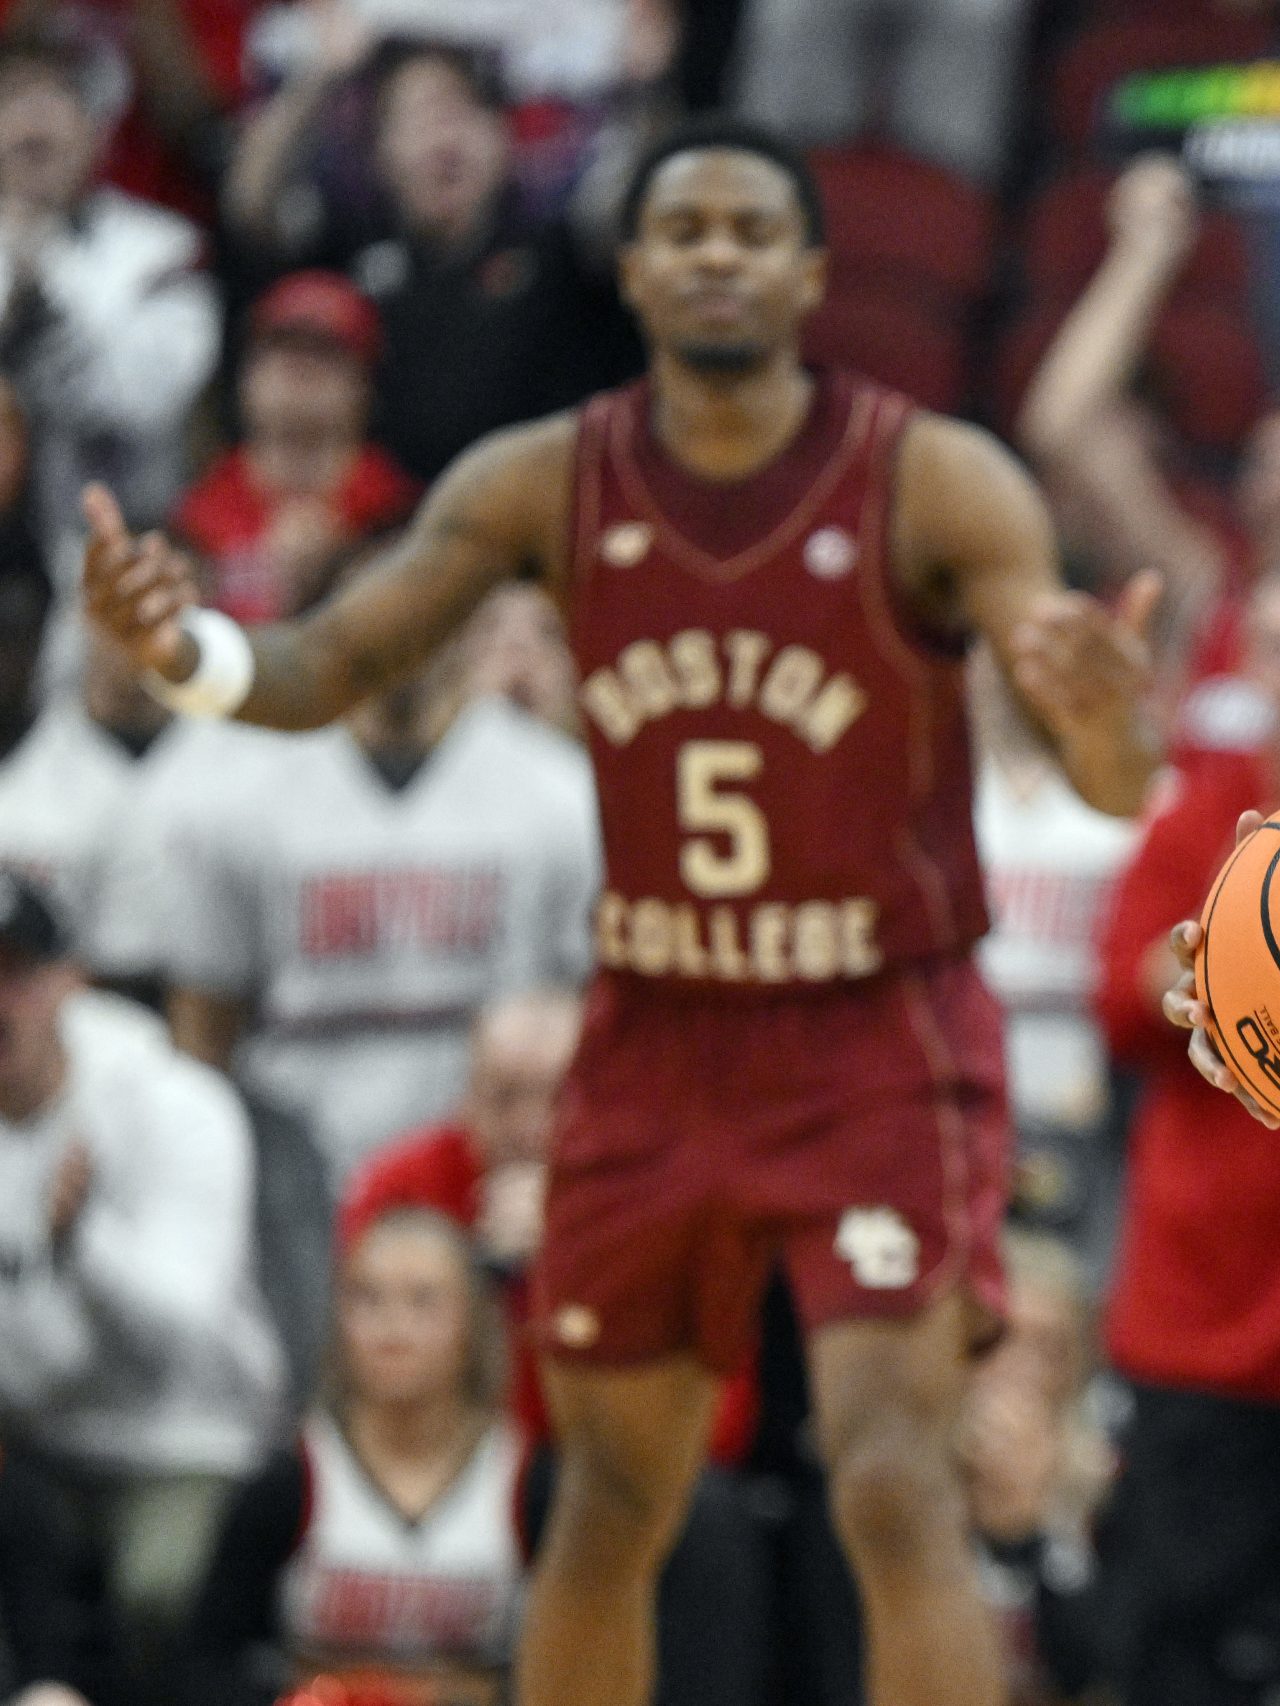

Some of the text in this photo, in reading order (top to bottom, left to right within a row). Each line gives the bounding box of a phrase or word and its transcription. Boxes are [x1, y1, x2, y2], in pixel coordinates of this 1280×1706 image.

[581, 626, 870, 754] BOSTON
[676, 738, 770, 898] 5
[597, 890, 885, 982] COLLEGE
[1259, 1004, 1279, 1036] BALL
